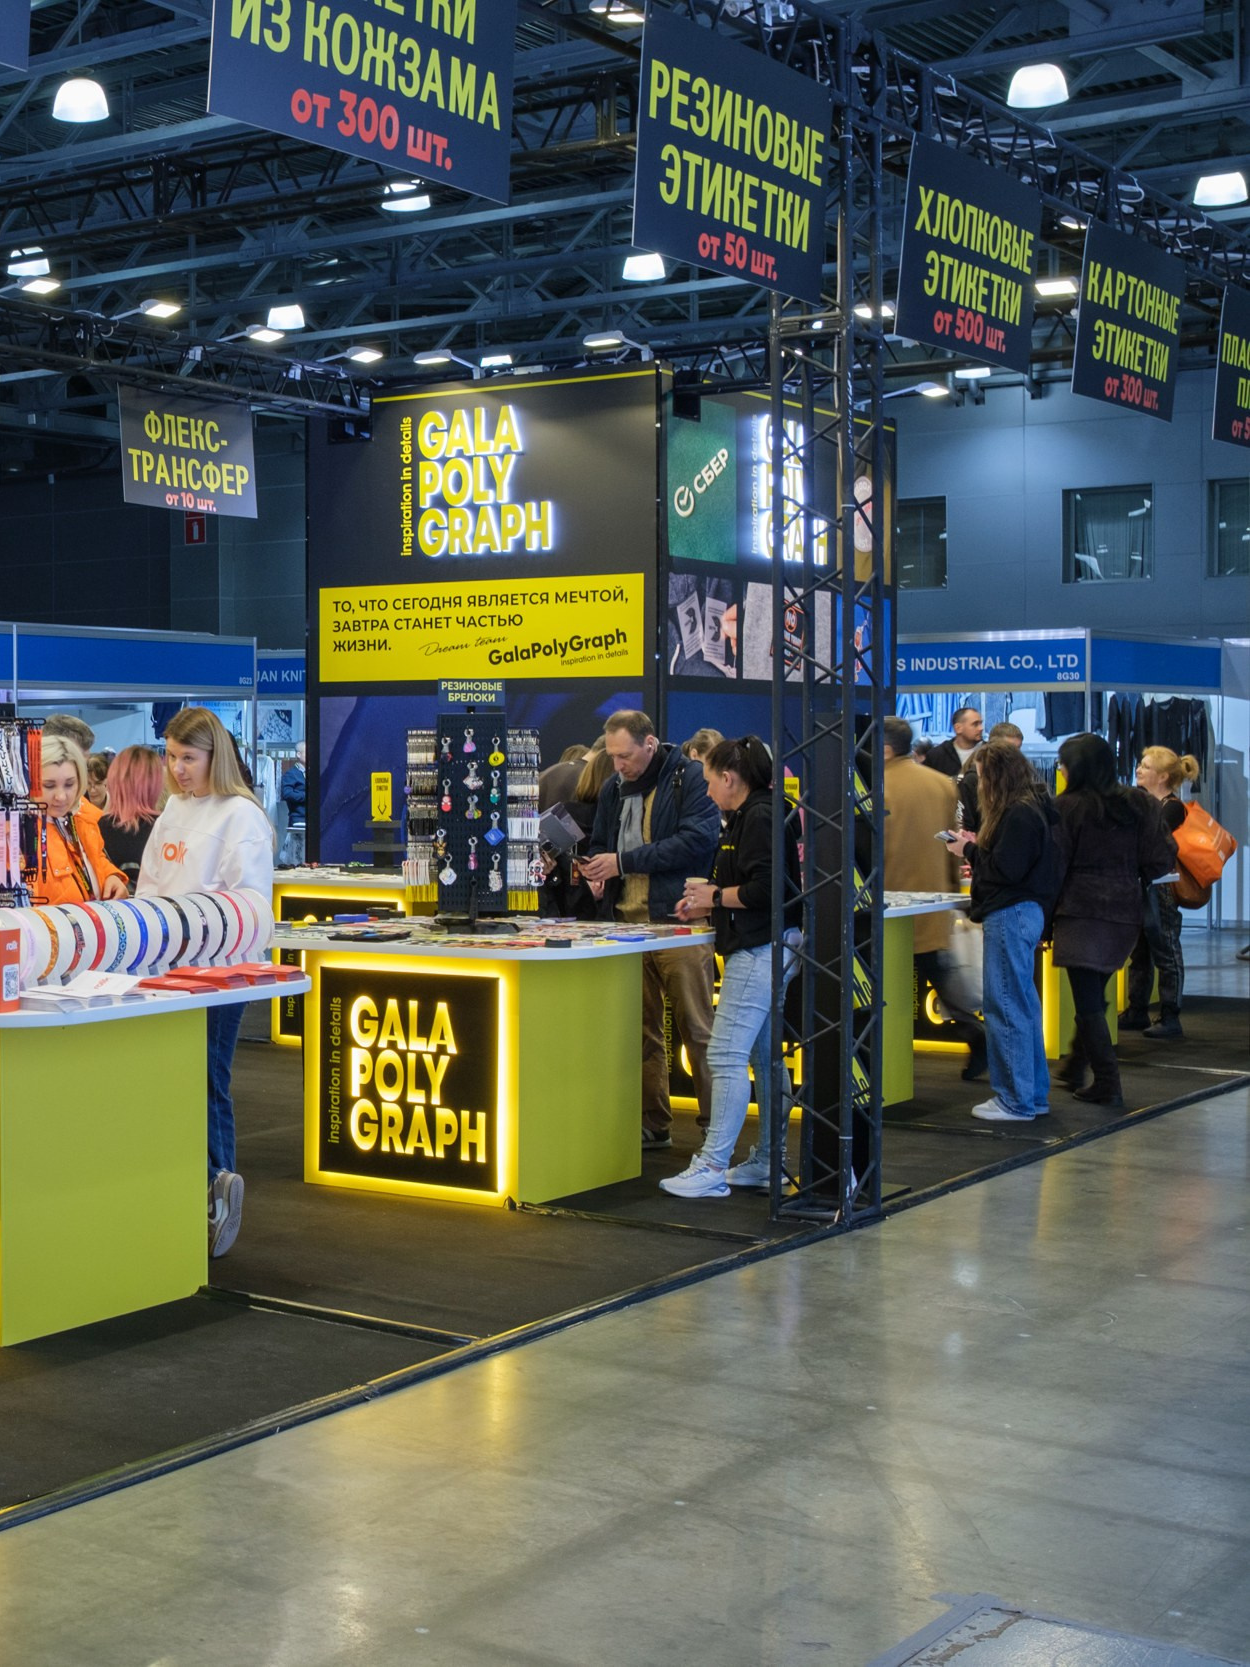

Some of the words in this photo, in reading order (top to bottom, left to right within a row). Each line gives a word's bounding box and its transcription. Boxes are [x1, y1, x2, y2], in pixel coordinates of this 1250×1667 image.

[230, 0, 291, 52] ИЗ
[304, 1, 501, 131] КОЖЗАМА
[291, 88, 331, 128] от
[337, 88, 400, 150] 300
[406, 125, 452, 171] шт.
[649, 58, 825, 187] РЕЗИНОВЫЕ
[659, 144, 811, 253] ЭТИКЕТКИ
[914, 186, 1035, 275] ХЛОПКОВЫЕ
[698, 232, 720, 261] от
[723, 231, 747, 270] 50
[750, 249, 777, 282] шт.
[924, 250, 1022, 326] ЭТИКЕТКИ
[1086, 261, 1181, 336] КАРТОННЫЕ
[933, 310, 951, 336] от
[954, 309, 984, 344] 500
[985, 325, 1006, 353] шт.
[1092, 319, 1169, 383] ЭТИКЕТКИ
[1104, 375, 1119, 398] от
[1120, 374, 1142, 405] 300
[144, 410, 228, 453] ФЛЕКС-
[401, 416, 412, 464] details
[418, 405, 522, 460] GALA
[128, 448, 249, 496] ТРАНСФЕР
[401, 467, 412, 481] in
[419, 454, 516, 508] POLY
[693, 448, 729, 494] СБЕР
[166, 493, 179, 506] от
[180, 492, 195, 509] 10
[401, 484, 412, 557] inspiration
[418, 501, 553, 557] GRAPH
[332, 619, 389, 633] ЗАВТРА
[393, 616, 452, 631] СТАНЕТ
[456, 613, 523, 628] ЧАСТЬЮ
[333, 601, 356, 617] ТО,
[359, 599, 388, 612] ЧТО
[392, 595, 463, 612] СЕГОДНЯ
[467, 592, 549, 607] ЯВЛЯЕТСЯ
[555, 586, 629, 604] МЕЧТОЙ,
[332, 638, 392, 652] ЖИЗНИ.
[488, 628, 628, 666] GalaPolyGraph
[911, 655, 1005, 672] INDUSTRIAL
[1009, 655, 1043, 672] CO.,
[1048, 654, 1078, 669] LTD
[441, 681, 503, 692] РЕЗИНОВЫЕ
[448, 692, 495, 703] БРЕЛОКИ
[1057, 672, 1080, 681] 8G30
[330, 996, 342, 1047] details
[350, 995, 458, 1054] GALA
[329, 1050, 341, 1063] in
[351, 1047, 450, 1105] POLY
[328, 1067, 342, 1144] inspiration
[350, 1098, 486, 1163] GRAPH
